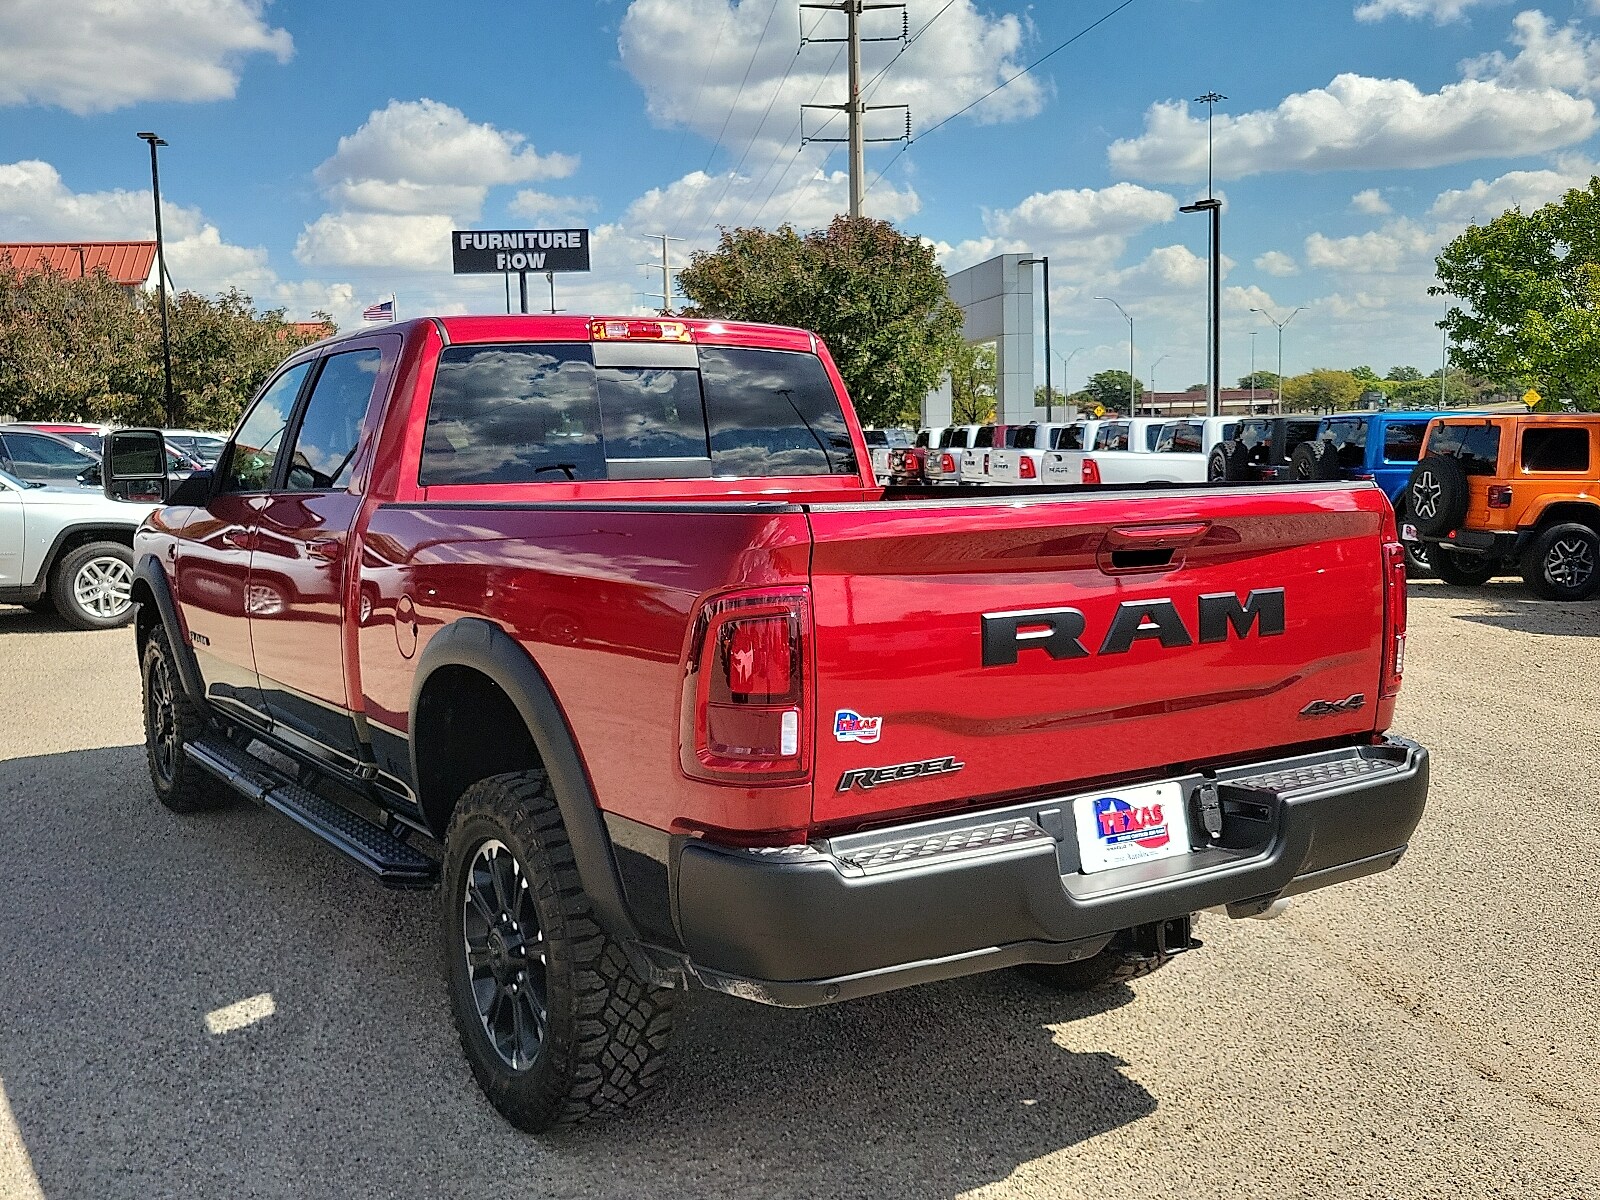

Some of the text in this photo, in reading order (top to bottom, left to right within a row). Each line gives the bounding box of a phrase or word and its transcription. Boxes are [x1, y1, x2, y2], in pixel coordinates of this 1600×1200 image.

[460, 232, 582, 249] FURNITURE
[496, 253, 547, 270] ROW
[980, 587, 1286, 668] RAM
[838, 719, 878, 731] TEXAS
[837, 755, 966, 791] REBEL
[1098, 803, 1164, 835] TEXAS
